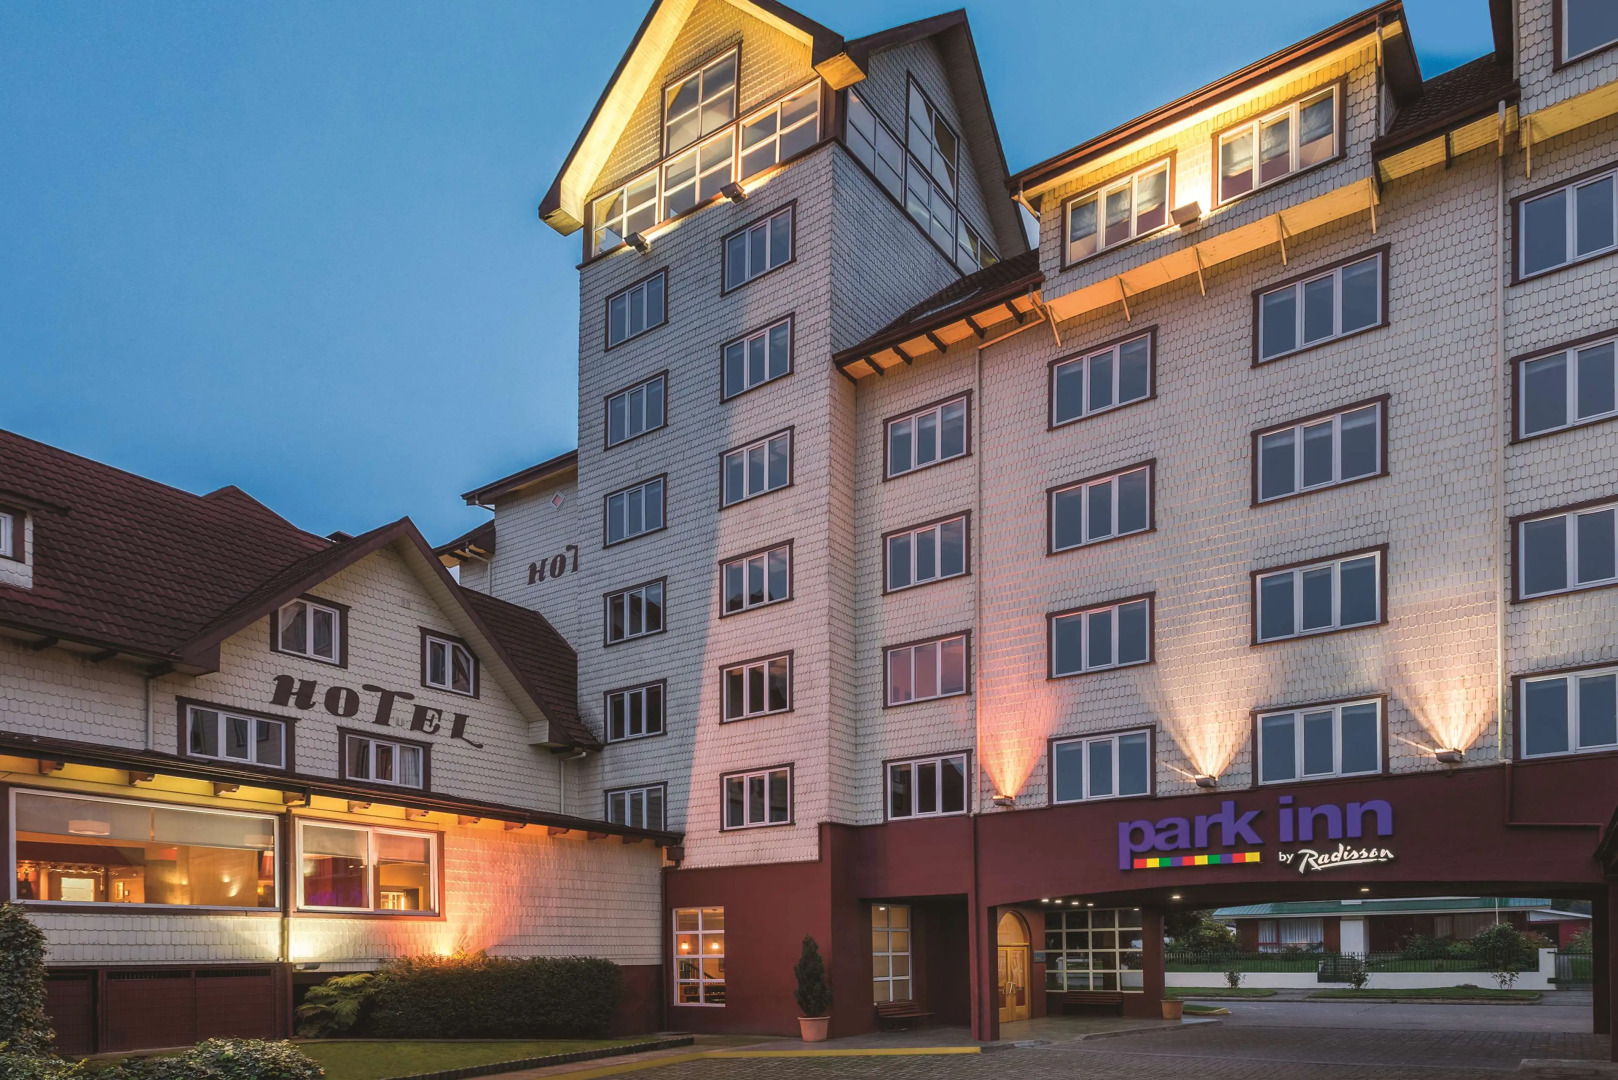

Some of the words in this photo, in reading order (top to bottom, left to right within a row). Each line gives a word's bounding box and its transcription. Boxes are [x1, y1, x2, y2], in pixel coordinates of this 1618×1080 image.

[269, 674, 483, 749] HOTEL
[1118, 800, 1264, 870] park
[1279, 795, 1393, 842] inn
[1278, 851, 1294, 864] by
[1298, 843, 1394, 873] Radisson
